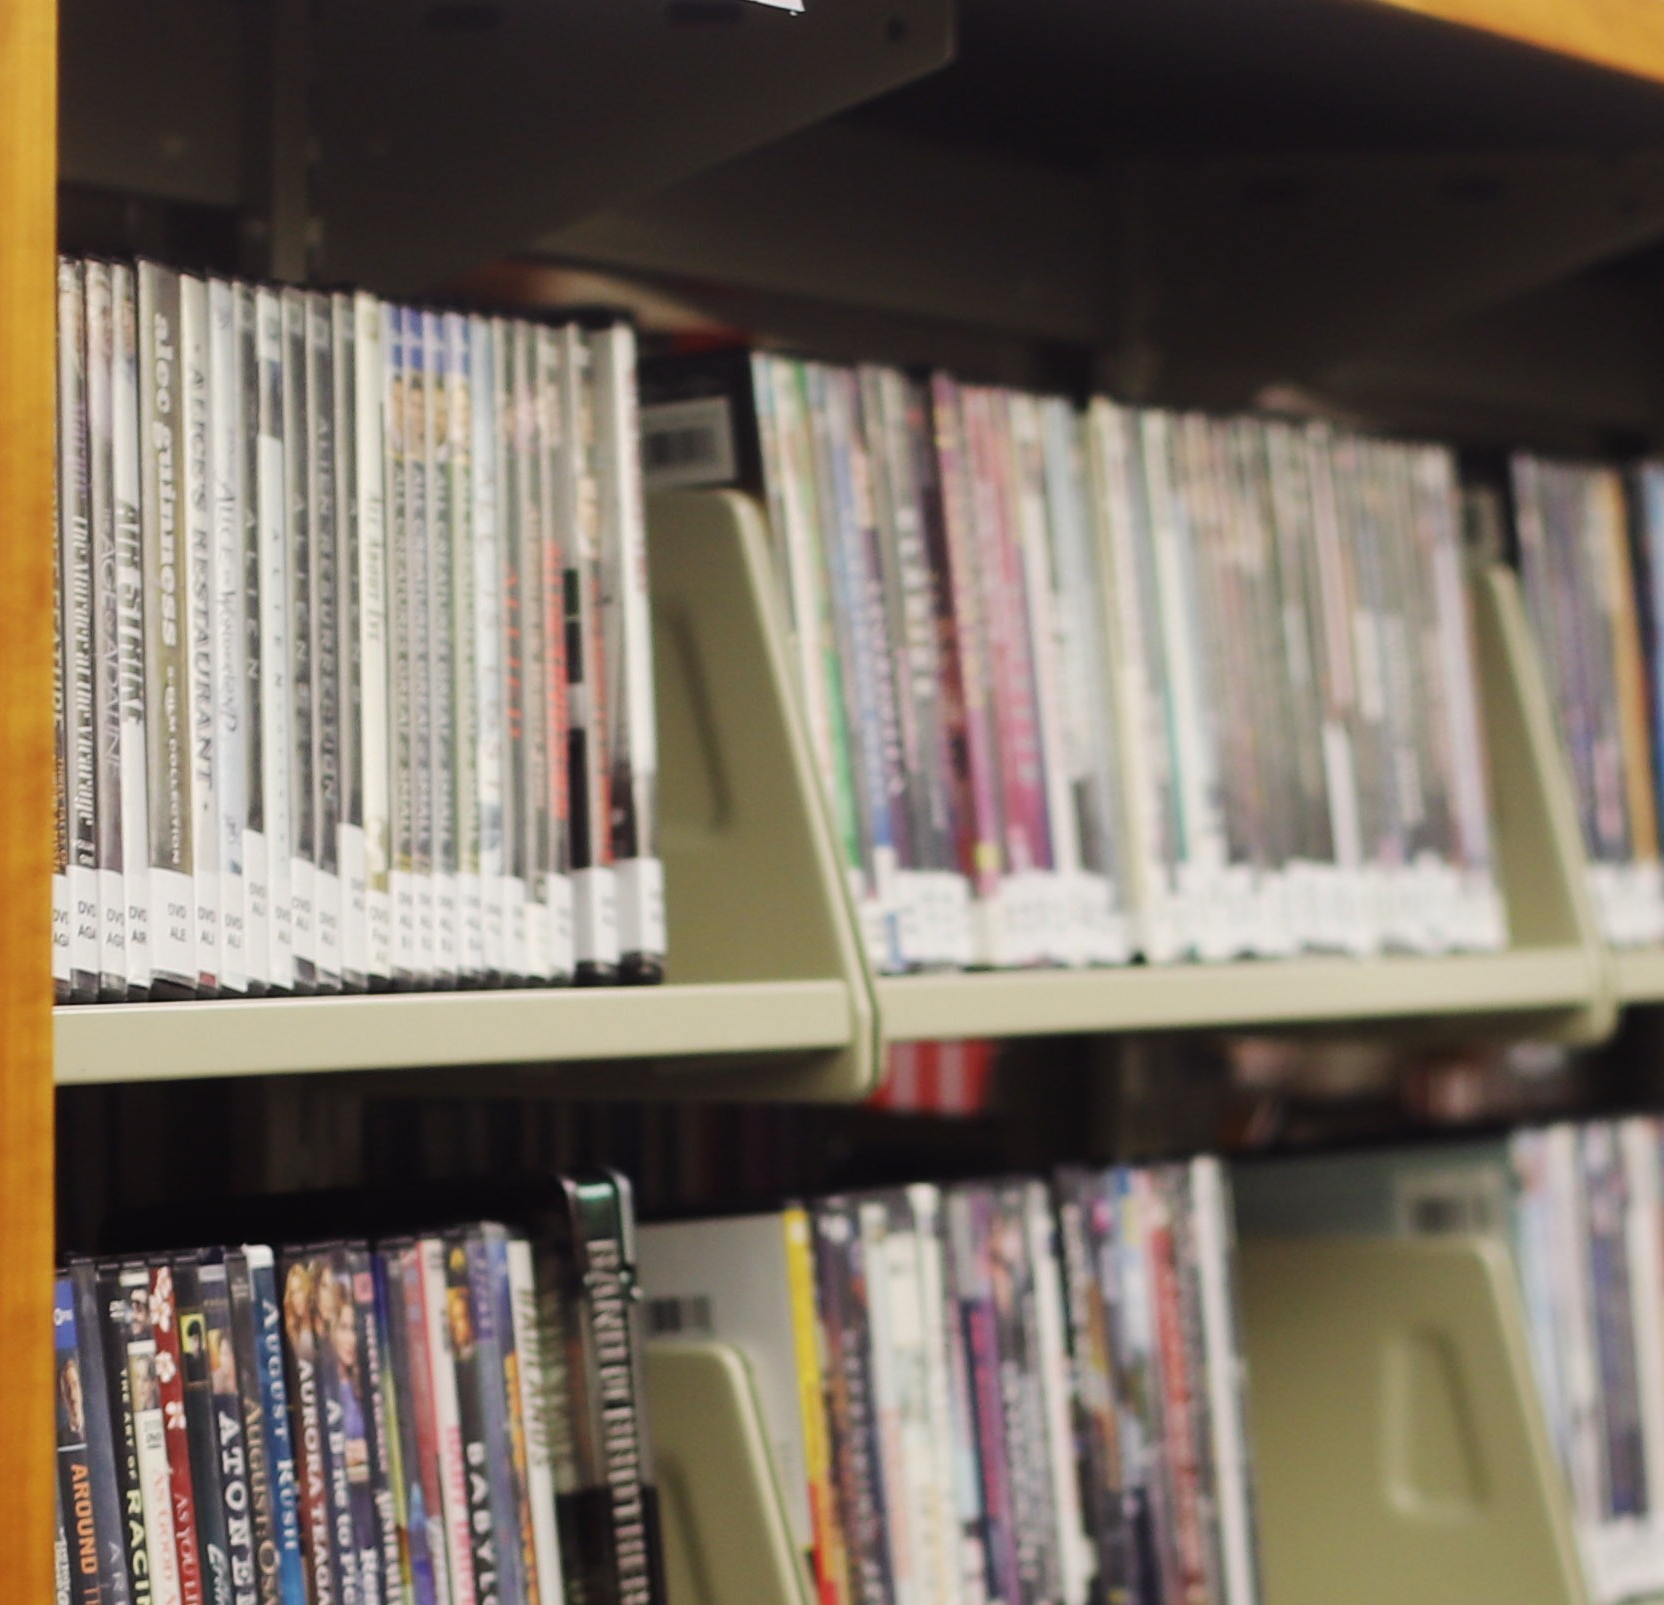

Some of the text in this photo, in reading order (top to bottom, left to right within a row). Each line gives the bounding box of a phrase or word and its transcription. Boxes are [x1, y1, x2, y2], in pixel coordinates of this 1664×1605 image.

[73, 515, 87, 556] The
[154, 421, 178, 646] guinness
[190, 369, 213, 790] ALICE'S RESTAURANT
[245, 508, 262, 681] ALIEN
[74, 561, 90, 649] Murder
[119, 582, 144, 728] STRIKE
[272, 529, 284, 690] ALIEN
[102, 629, 122, 778] ADALINE
[74, 727, 95, 826] Vicarage
[167, 738, 182, 864] COLLECTION
[167, 903, 186, 920] DVD
[170, 926, 186, 942] ALE
[120, 1368, 130, 1403] THE
[123, 1411, 134, 1447] ART
[261, 1300, 299, 1550] AUGUST RUSH
[297, 1358, 325, 1495] AURORA
[127, 1455, 137, 1481] OF
[174, 1494, 189, 1522] AS
[244, 1397, 273, 1537] AUGUST:
[325, 1399, 344, 1425] A
[337, 1513, 353, 1546] to
[71, 1463, 102, 1605] AROUND T
[108, 1541, 131, 1605] AR
[176, 1525, 196, 1577] YOU
